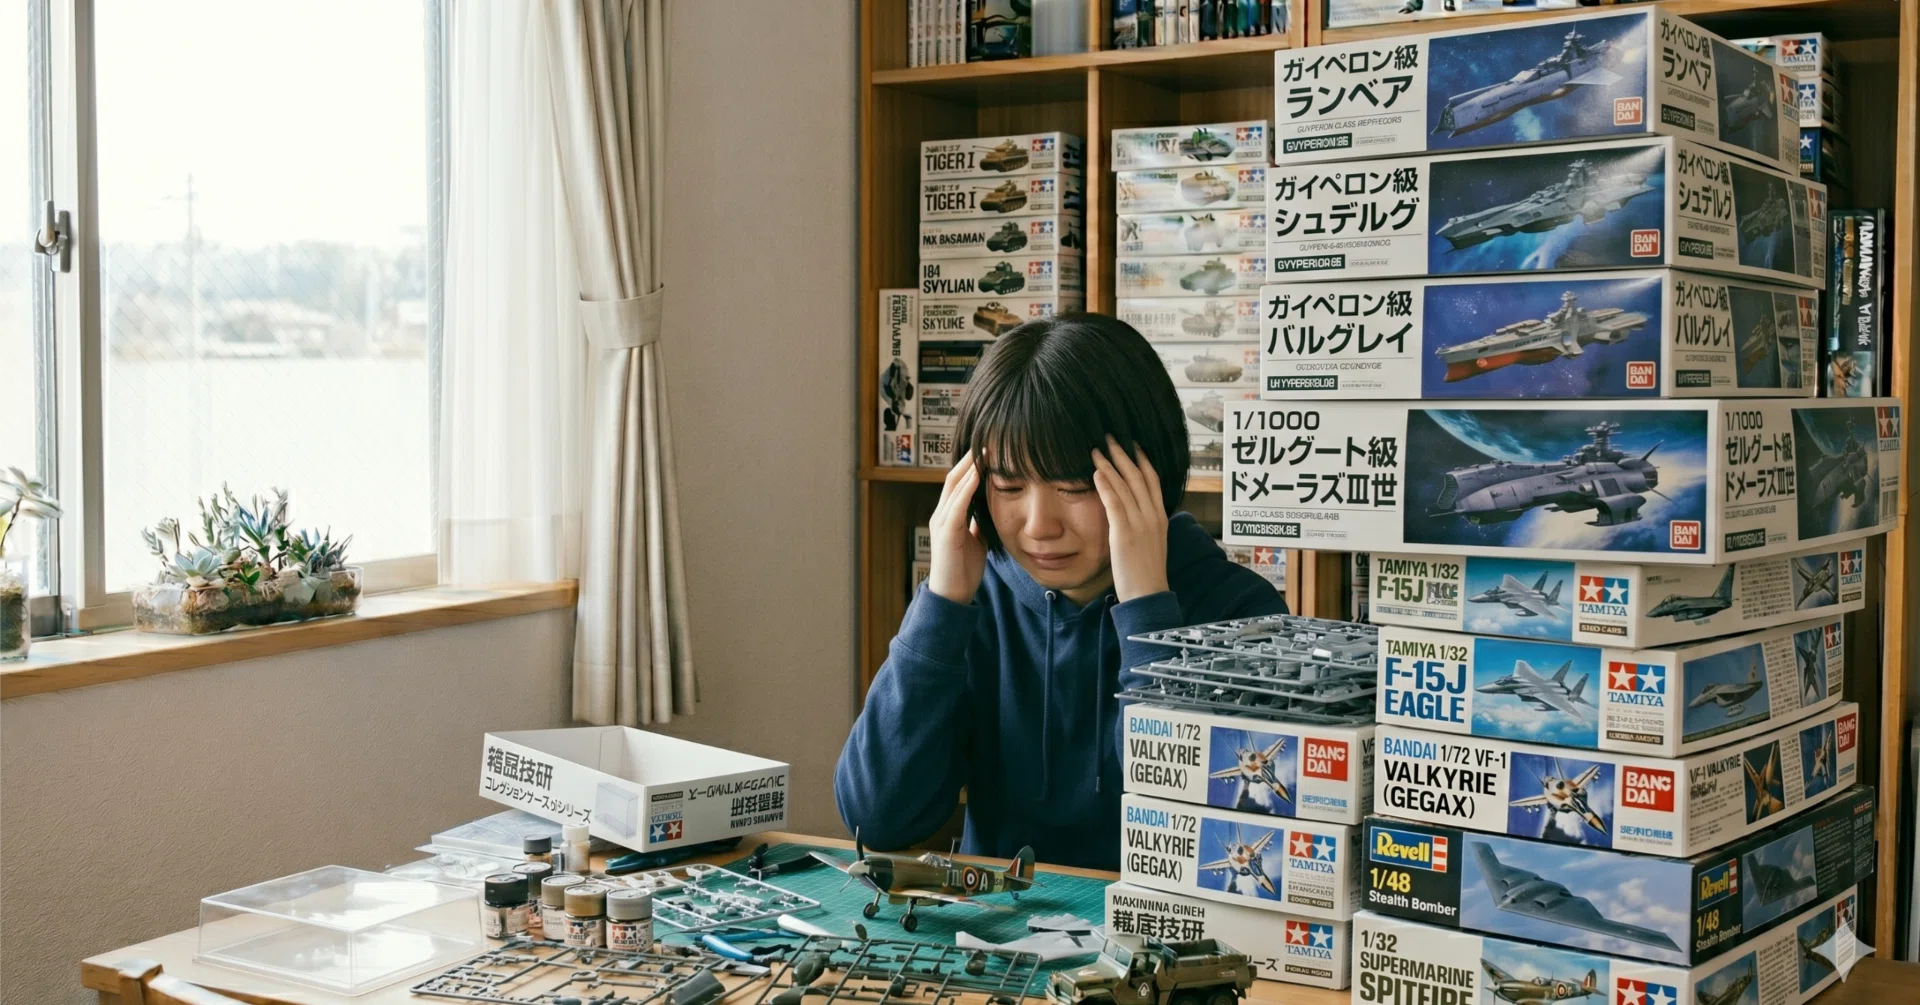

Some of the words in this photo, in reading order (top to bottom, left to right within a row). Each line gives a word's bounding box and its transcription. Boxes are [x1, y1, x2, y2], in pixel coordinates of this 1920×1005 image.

[1283, 43, 1419, 83] ガイペロン級
[1286, 75, 1414, 119] ランベア
[1617, 102, 1639, 112] BAN
[1617, 111, 1634, 121] DAI
[925, 152, 965, 171] TIGER
[1275, 167, 1419, 201] ガイペロン級
[925, 192, 965, 211] TIGER
[1275, 197, 1420, 237] シュデルグ
[1634, 233, 1656, 244] BAN
[1634, 243, 1652, 253] DAI
[923, 279, 974, 294] SVYLIAN
[1267, 290, 1412, 320] ガイペロン級
[1267, 322, 1414, 355] バルグレイ
[1630, 366, 1651, 376] BAN
[1630, 375, 1648, 385] DAI
[1232, 411, 1320, 431] 1/1000
[1725, 411, 1763, 431] 1/1000
[1231, 435, 1397, 468] ゼルグート級
[1674, 525, 1697, 535] BAN
[1674, 534, 1692, 544] DAI
[1378, 559, 1428, 577] TAMIYA
[1431, 563, 1459, 580] 1/32
[1377, 576, 1424, 602] F-15J
[1579, 603, 1628, 616] TAMIYA
[1386, 640, 1436, 659] TAMIYA
[1440, 645, 1467, 662] 1/32
[1385, 657, 1467, 694] F-15J
[1384, 689, 1465, 724] EAGLE
[1607, 692, 1665, 707] TAMIYA
[1130, 718, 1172, 737] BANDAI
[1176, 724, 1201, 741] 1/72
[1130, 738, 1201, 766] VALKYRIE
[1384, 737, 1437, 761] BANDAI
[1441, 744, 1470, 766] 1/72
[1475, 750, 1506, 769] VF-1
[1130, 762, 1188, 790] (GEGAX)
[1307, 758, 1331, 774] DAI
[1384, 759, 1497, 796] VALKYRIE
[1707, 755, 1741, 778] VALKYRIE
[1383, 784, 1476, 819] (GEGAX)
[1626, 788, 1655, 805] DAI
[1127, 806, 1169, 828] BANDAI
[1171, 814, 1196, 833] 1/72
[1127, 828, 1195, 859] VALKYRIE
[1375, 832, 1430, 862] Revell
[1127, 853, 1183, 882] (GEGAX)
[1289, 858, 1335, 874] TAMIYA
[1369, 868, 1411, 893] 1/48
[1369, 890, 1409, 908] Stealth
[1411, 897, 1457, 917] Bomber
[1697, 908, 1719, 937] 1/48
[1285, 945, 1332, 960] TAMIYA
[1361, 930, 1397, 953] 1/32
[1360, 951, 1474, 989] SUPERMARINE
